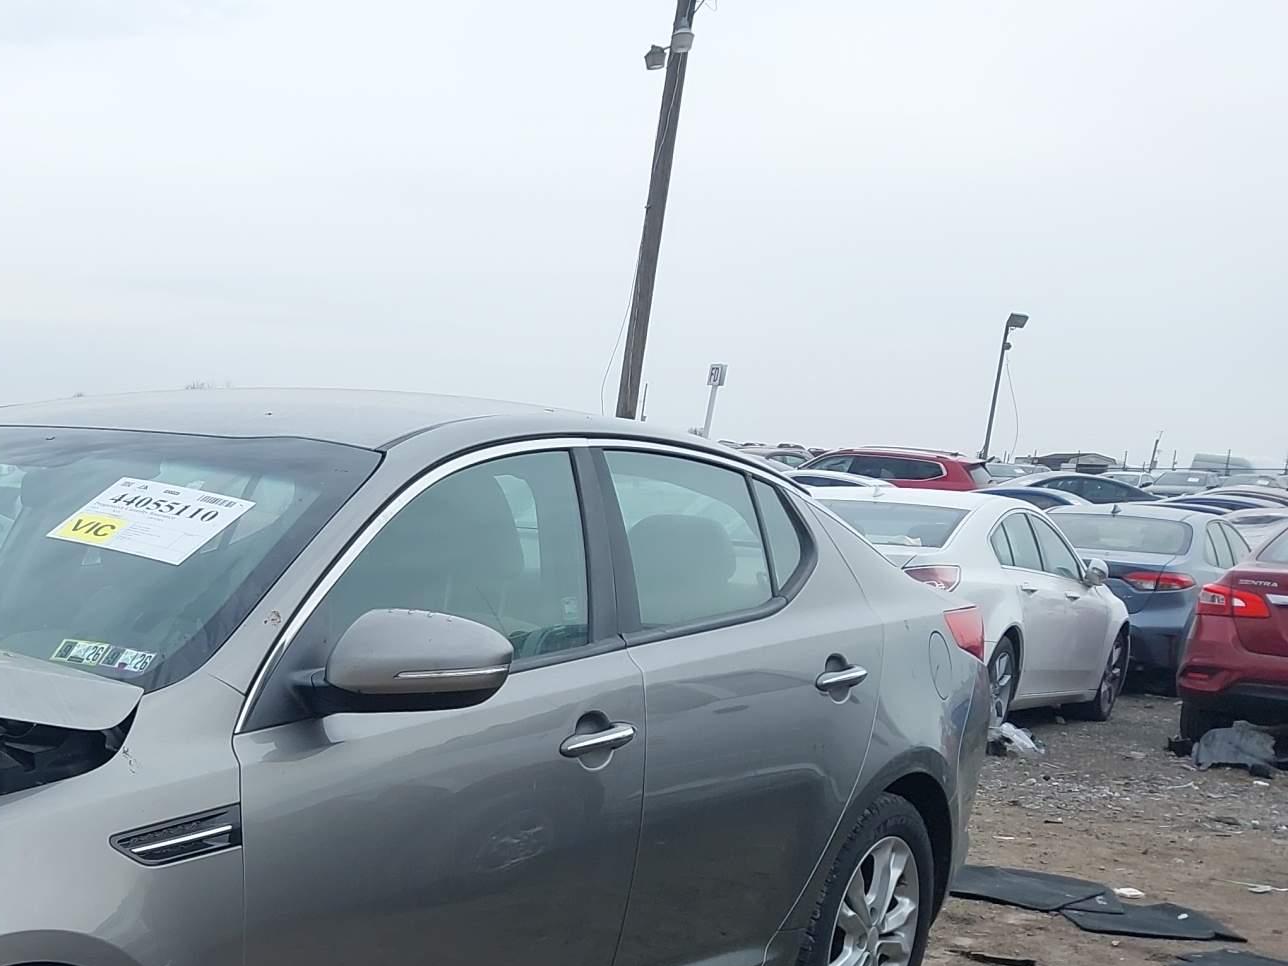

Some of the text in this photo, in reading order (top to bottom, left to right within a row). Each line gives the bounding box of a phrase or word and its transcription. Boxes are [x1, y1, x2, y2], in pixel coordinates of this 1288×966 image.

[110, 493, 220, 522] 44055110
[71, 519, 116, 537] VIC
[86, 645, 104, 661] 26
[132, 653, 153, 670] 26
